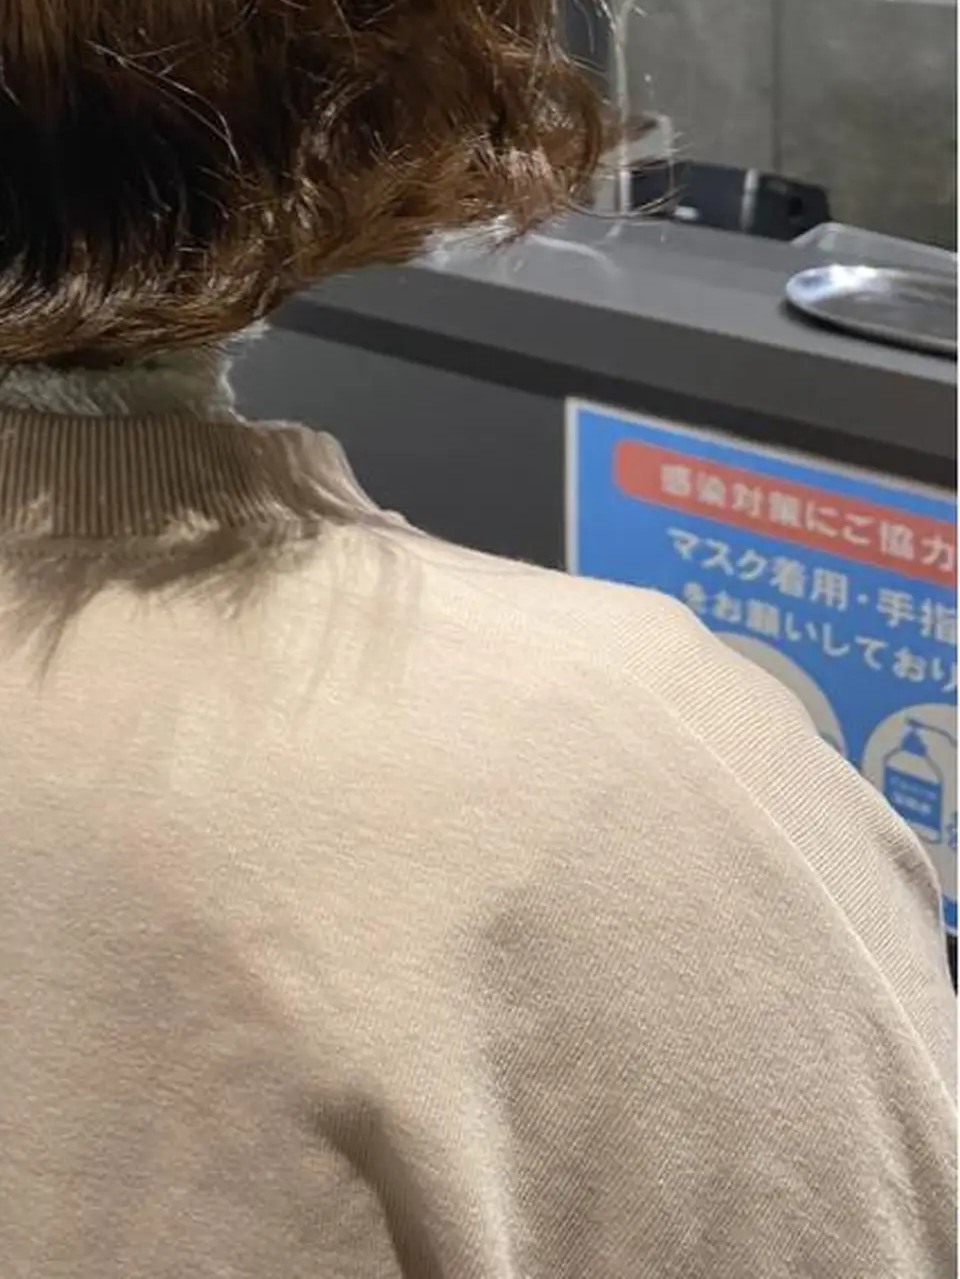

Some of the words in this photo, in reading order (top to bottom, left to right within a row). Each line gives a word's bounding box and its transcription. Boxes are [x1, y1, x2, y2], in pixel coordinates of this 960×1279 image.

[660, 463, 956, 572] 感染対策にご協力
